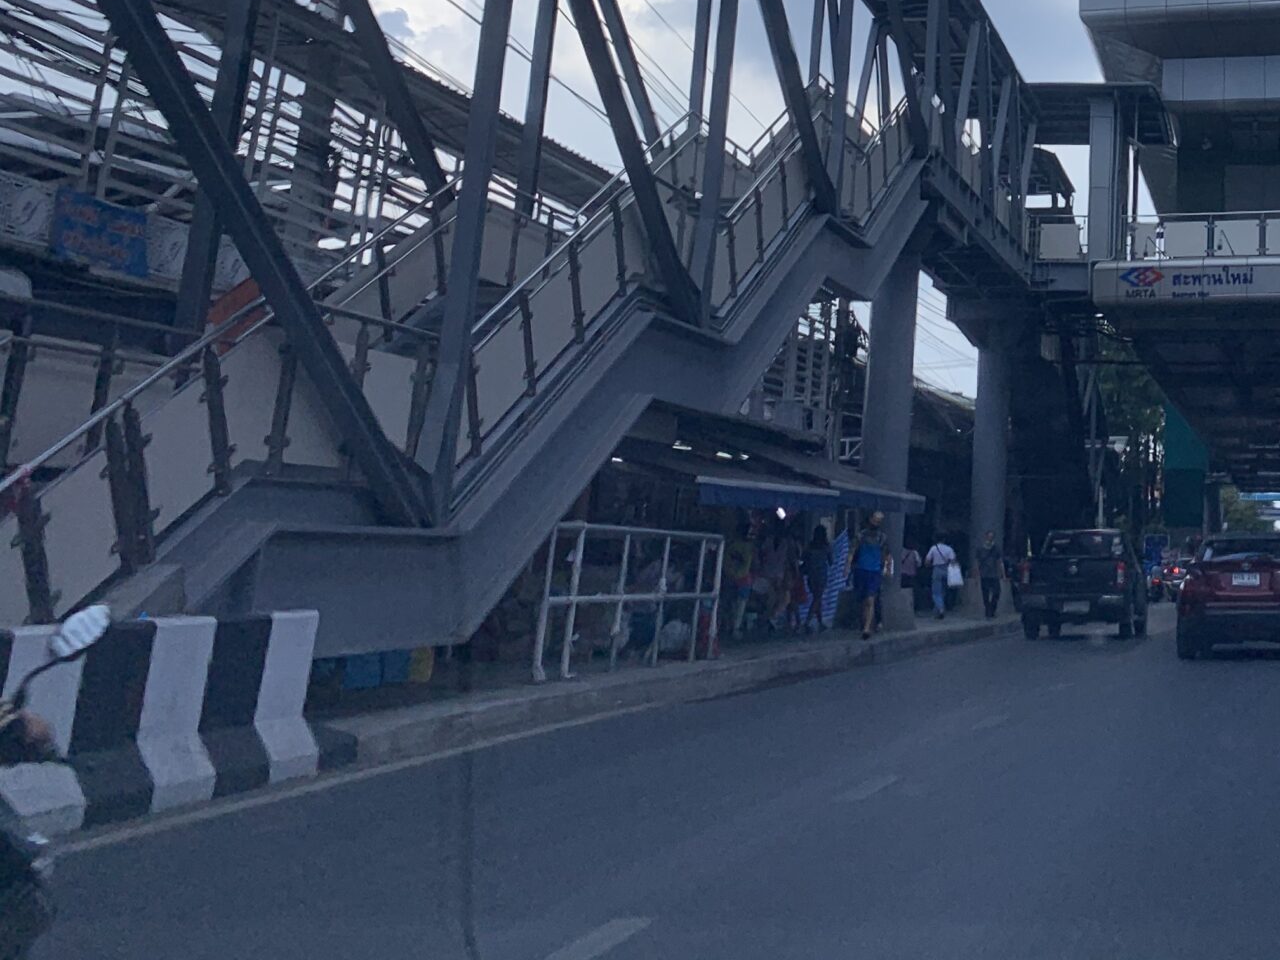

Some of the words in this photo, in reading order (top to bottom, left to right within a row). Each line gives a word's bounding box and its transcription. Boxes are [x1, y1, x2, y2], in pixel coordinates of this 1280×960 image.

[1172, 265, 1254, 287] สะพานใหม่
[1125, 288, 1157, 299] MRTA
